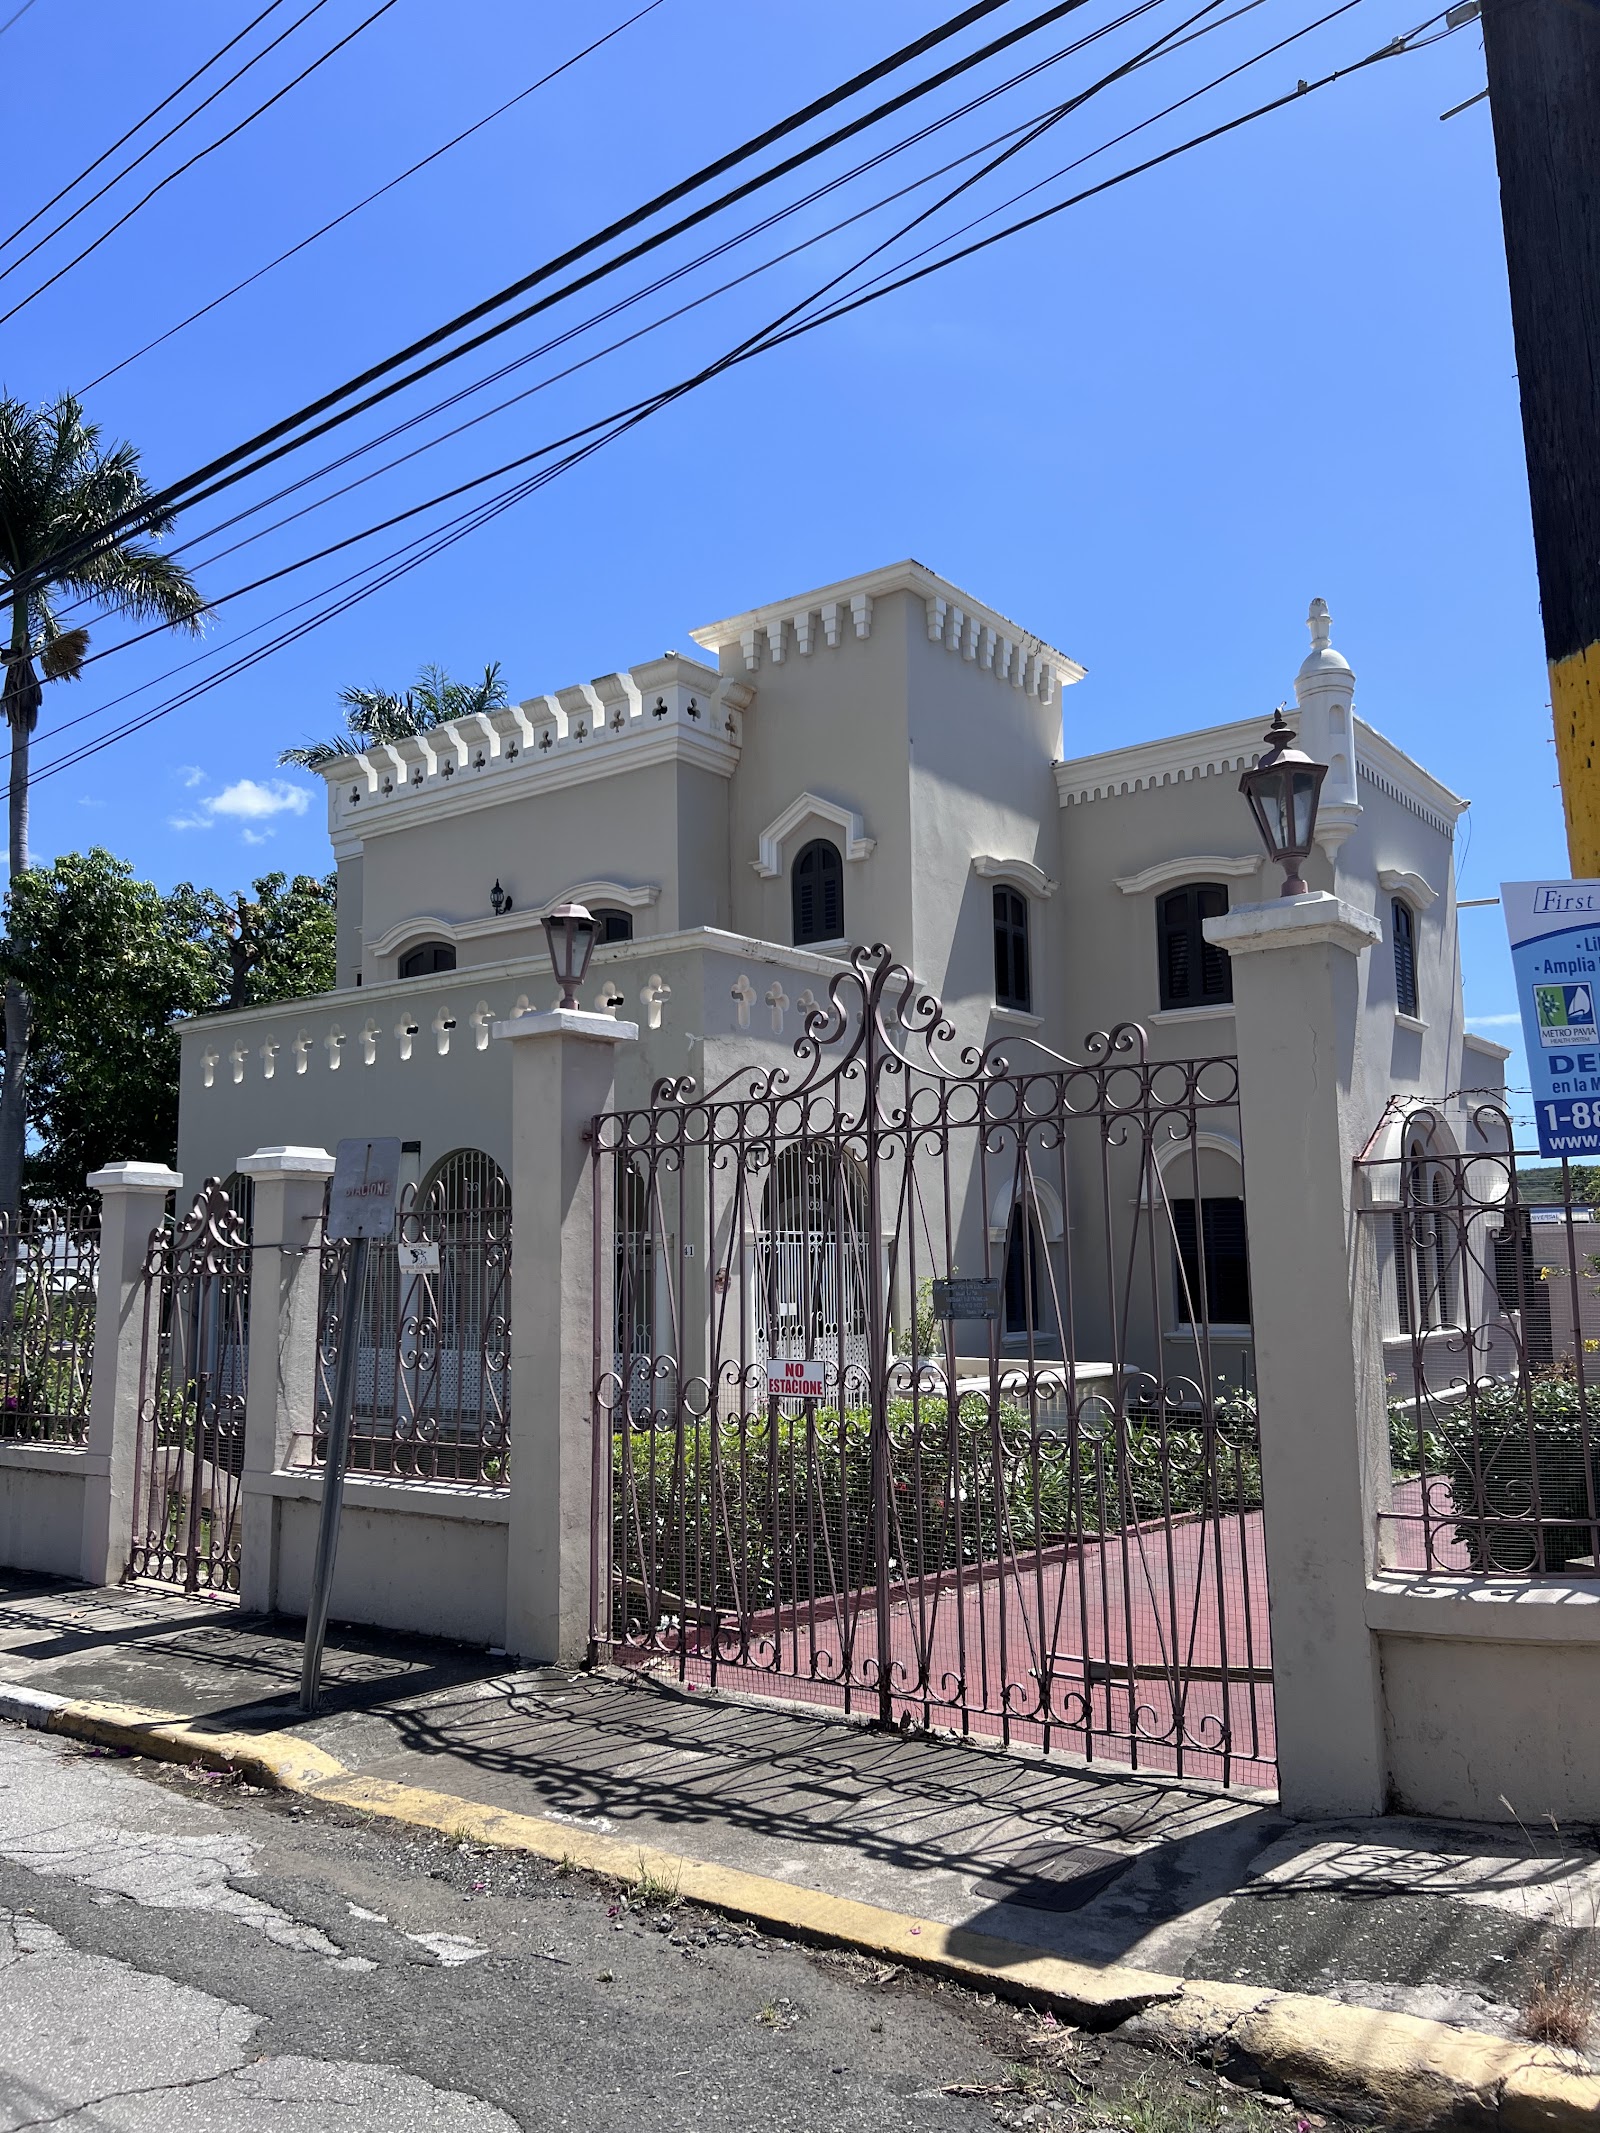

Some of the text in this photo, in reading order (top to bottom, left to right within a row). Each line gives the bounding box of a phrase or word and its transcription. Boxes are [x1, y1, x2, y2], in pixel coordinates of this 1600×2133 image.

[1542, 890, 1594, 911] First
[1543, 956, 1596, 977] Amplia
[1542, 1026, 1597, 1038] METRO PAVIA
[1548, 1052, 1600, 1075] DE
[1552, 1081, 1571, 1094] en
[1573, 1078, 1587, 1092] la
[785, 1362, 805, 1378] NO
[768, 1378, 823, 1396] ESTACIONE
